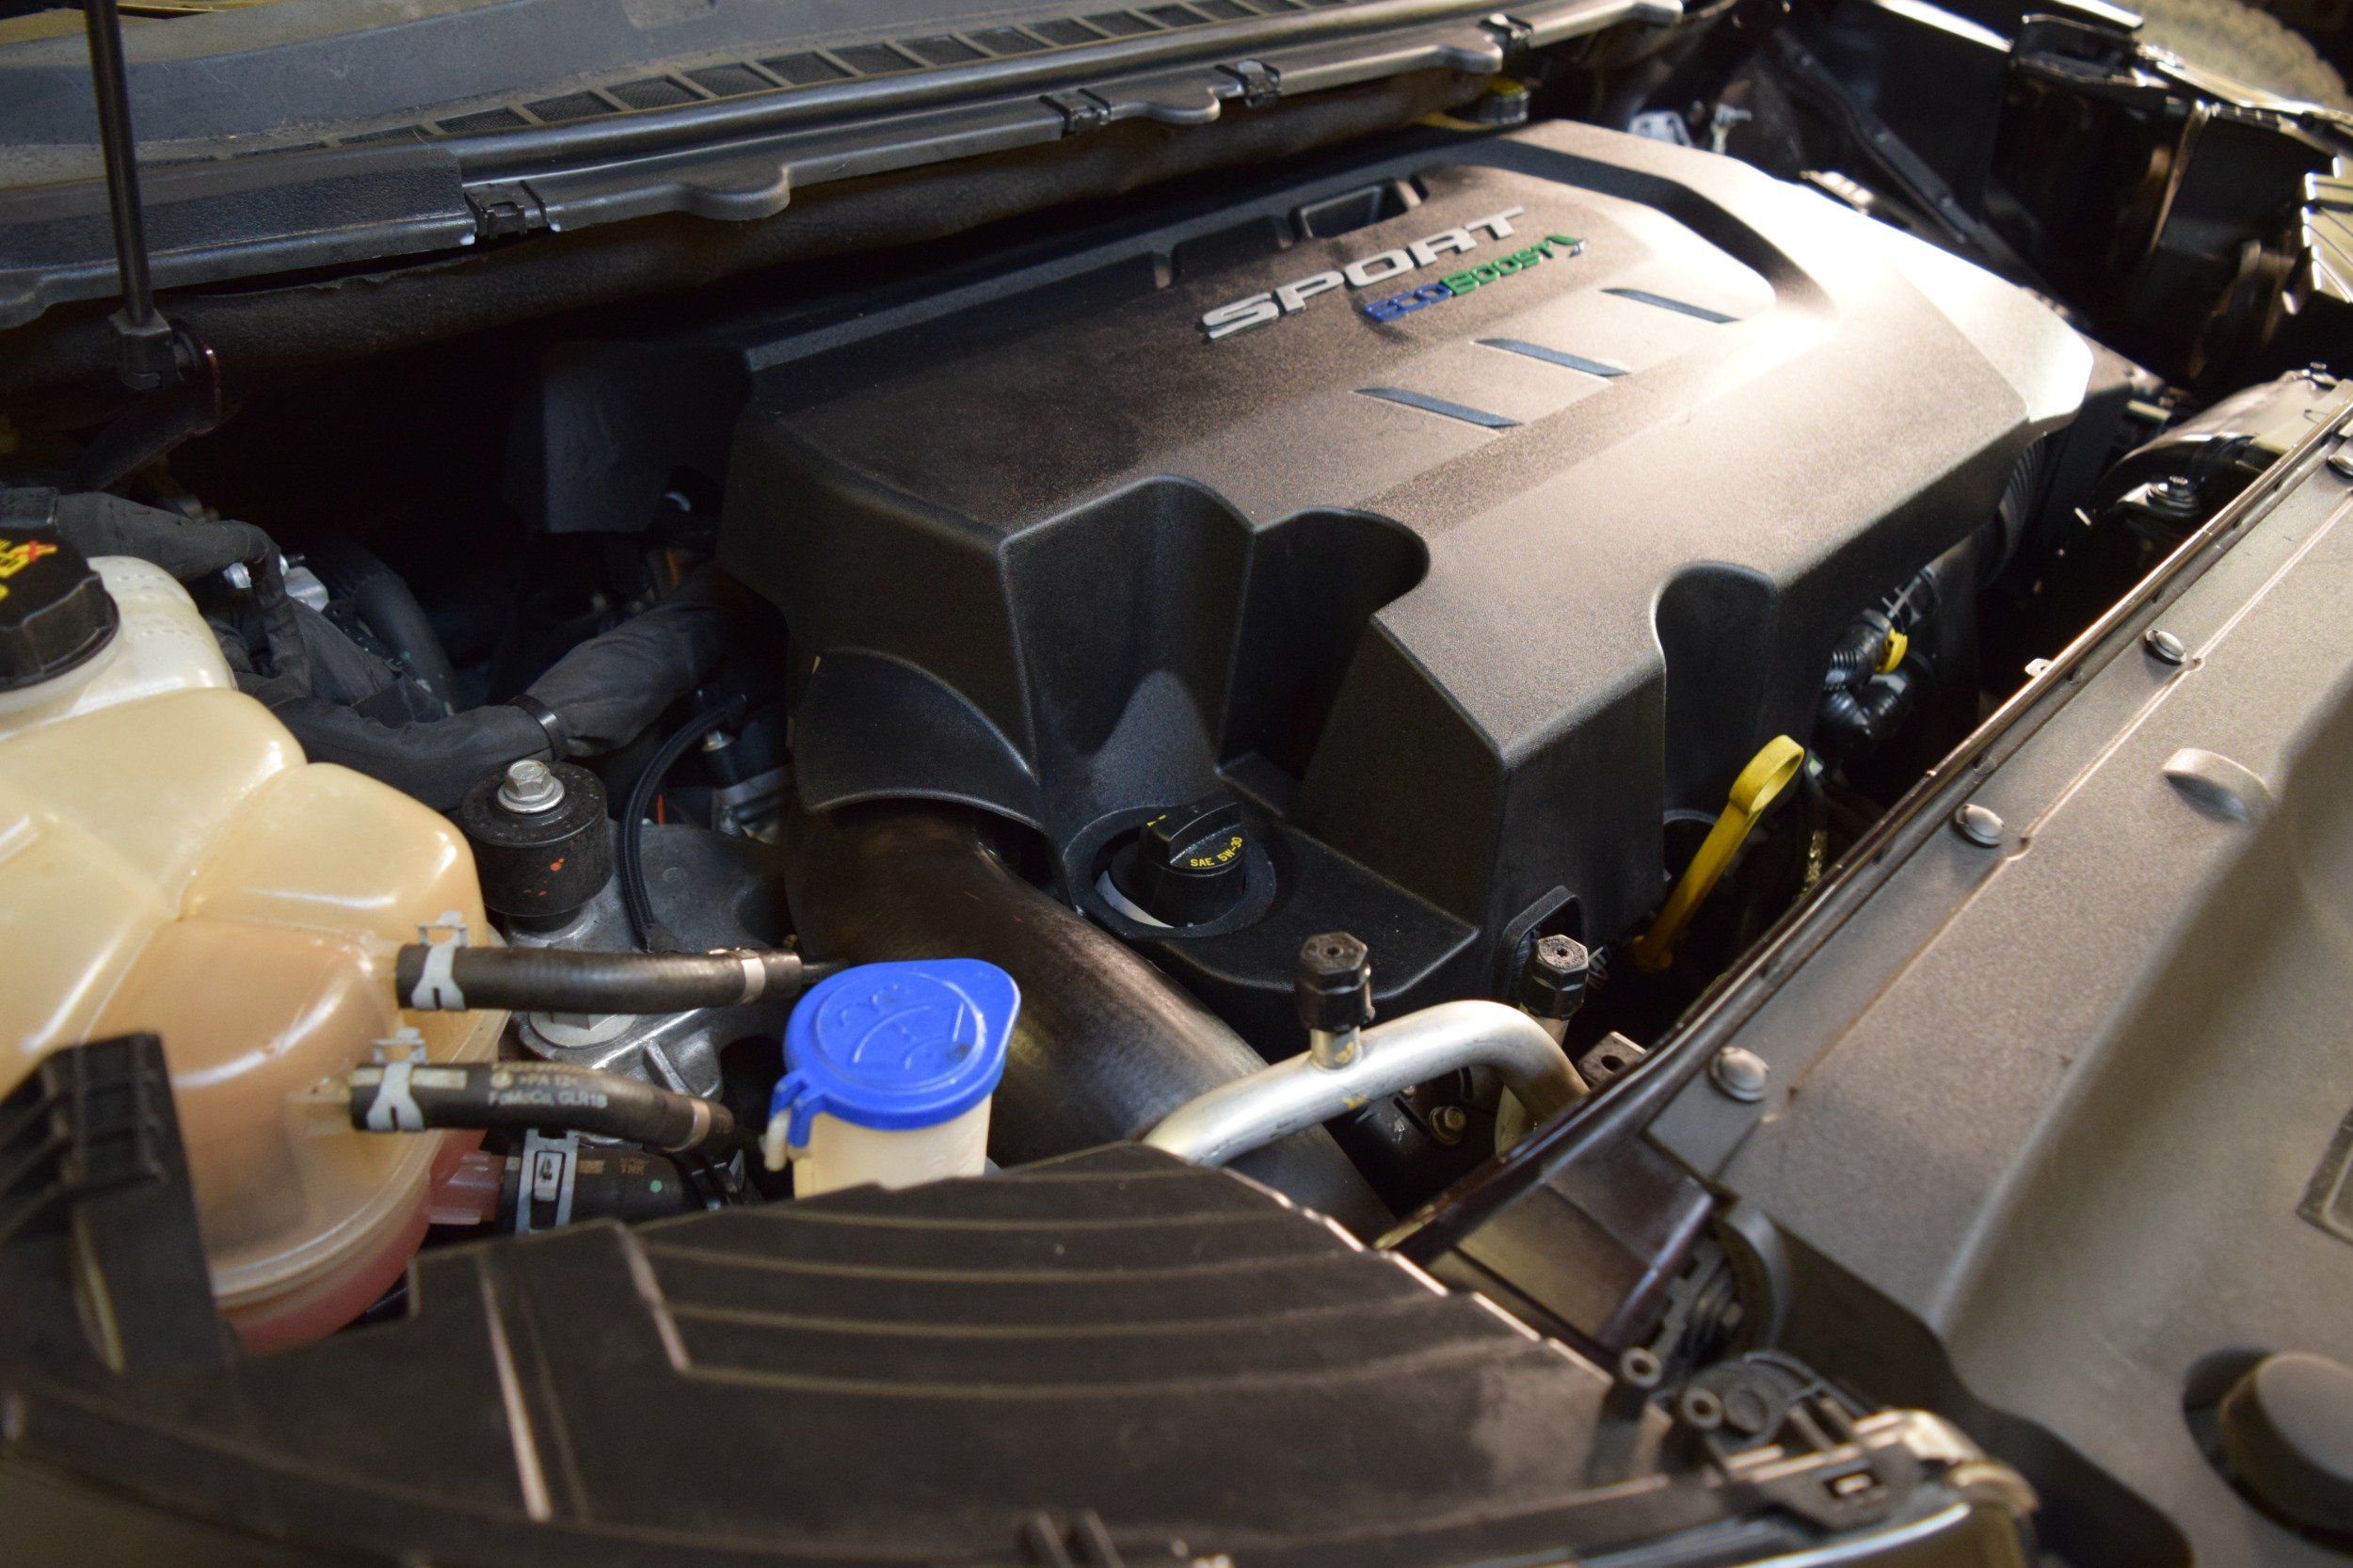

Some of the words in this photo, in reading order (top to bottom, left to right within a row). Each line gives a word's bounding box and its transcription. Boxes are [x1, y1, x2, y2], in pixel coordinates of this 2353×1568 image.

[1201, 206, 1525, 341] SPORT
[1190, 856, 1215, 867] SAE
[1216, 837, 1242, 862] 5W-30
